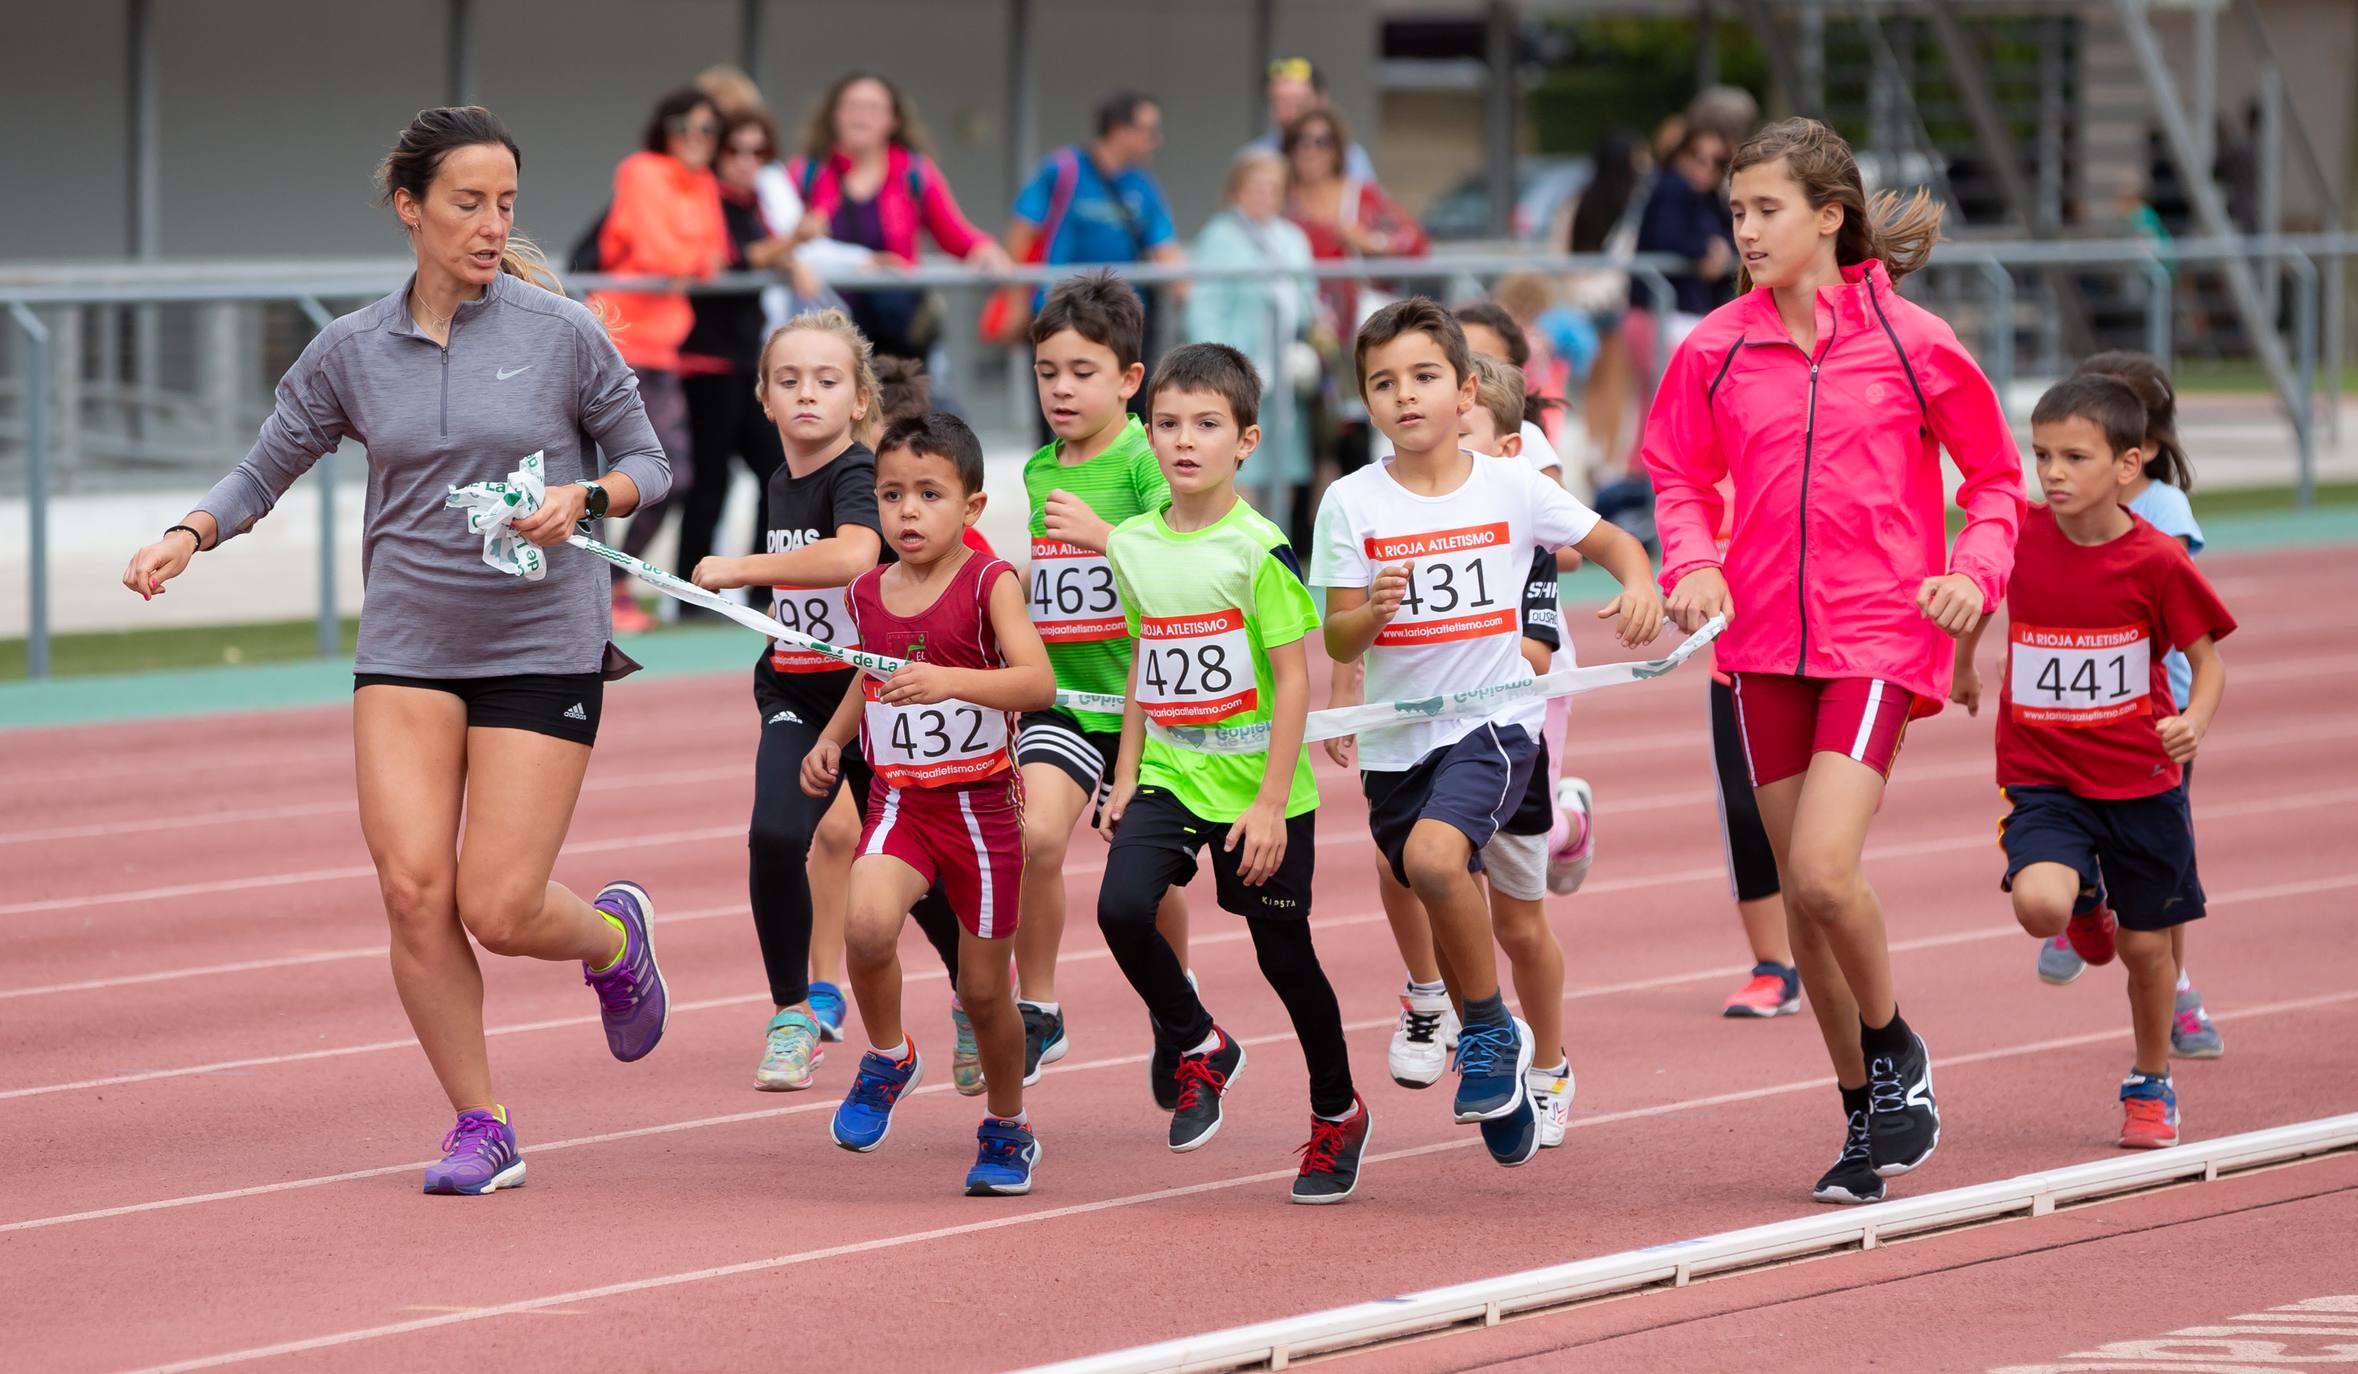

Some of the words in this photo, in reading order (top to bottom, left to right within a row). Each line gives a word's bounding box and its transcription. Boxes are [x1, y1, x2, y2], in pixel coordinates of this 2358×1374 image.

[767, 528, 820, 553] DIDAS
[1385, 542, 1426, 557] RIOJA
[1428, 531, 1495, 552] ATLETISMO
[1034, 565, 1117, 615] 463
[1399, 557, 1495, 615] 431
[773, 597, 835, 645] 98
[1166, 618, 1228, 636] ATLETISMO
[1382, 616, 1503, 639] www.lariojaatletismo.com
[2022, 631, 2034, 643] LA
[2036, 634, 2073, 647] RIOJA
[2076, 629, 2139, 647] ATLETISMO
[852, 653, 873, 668] de
[1146, 644, 1232, 696] 428
[2036, 654, 2131, 701] 441
[891, 708, 989, 760] 432
